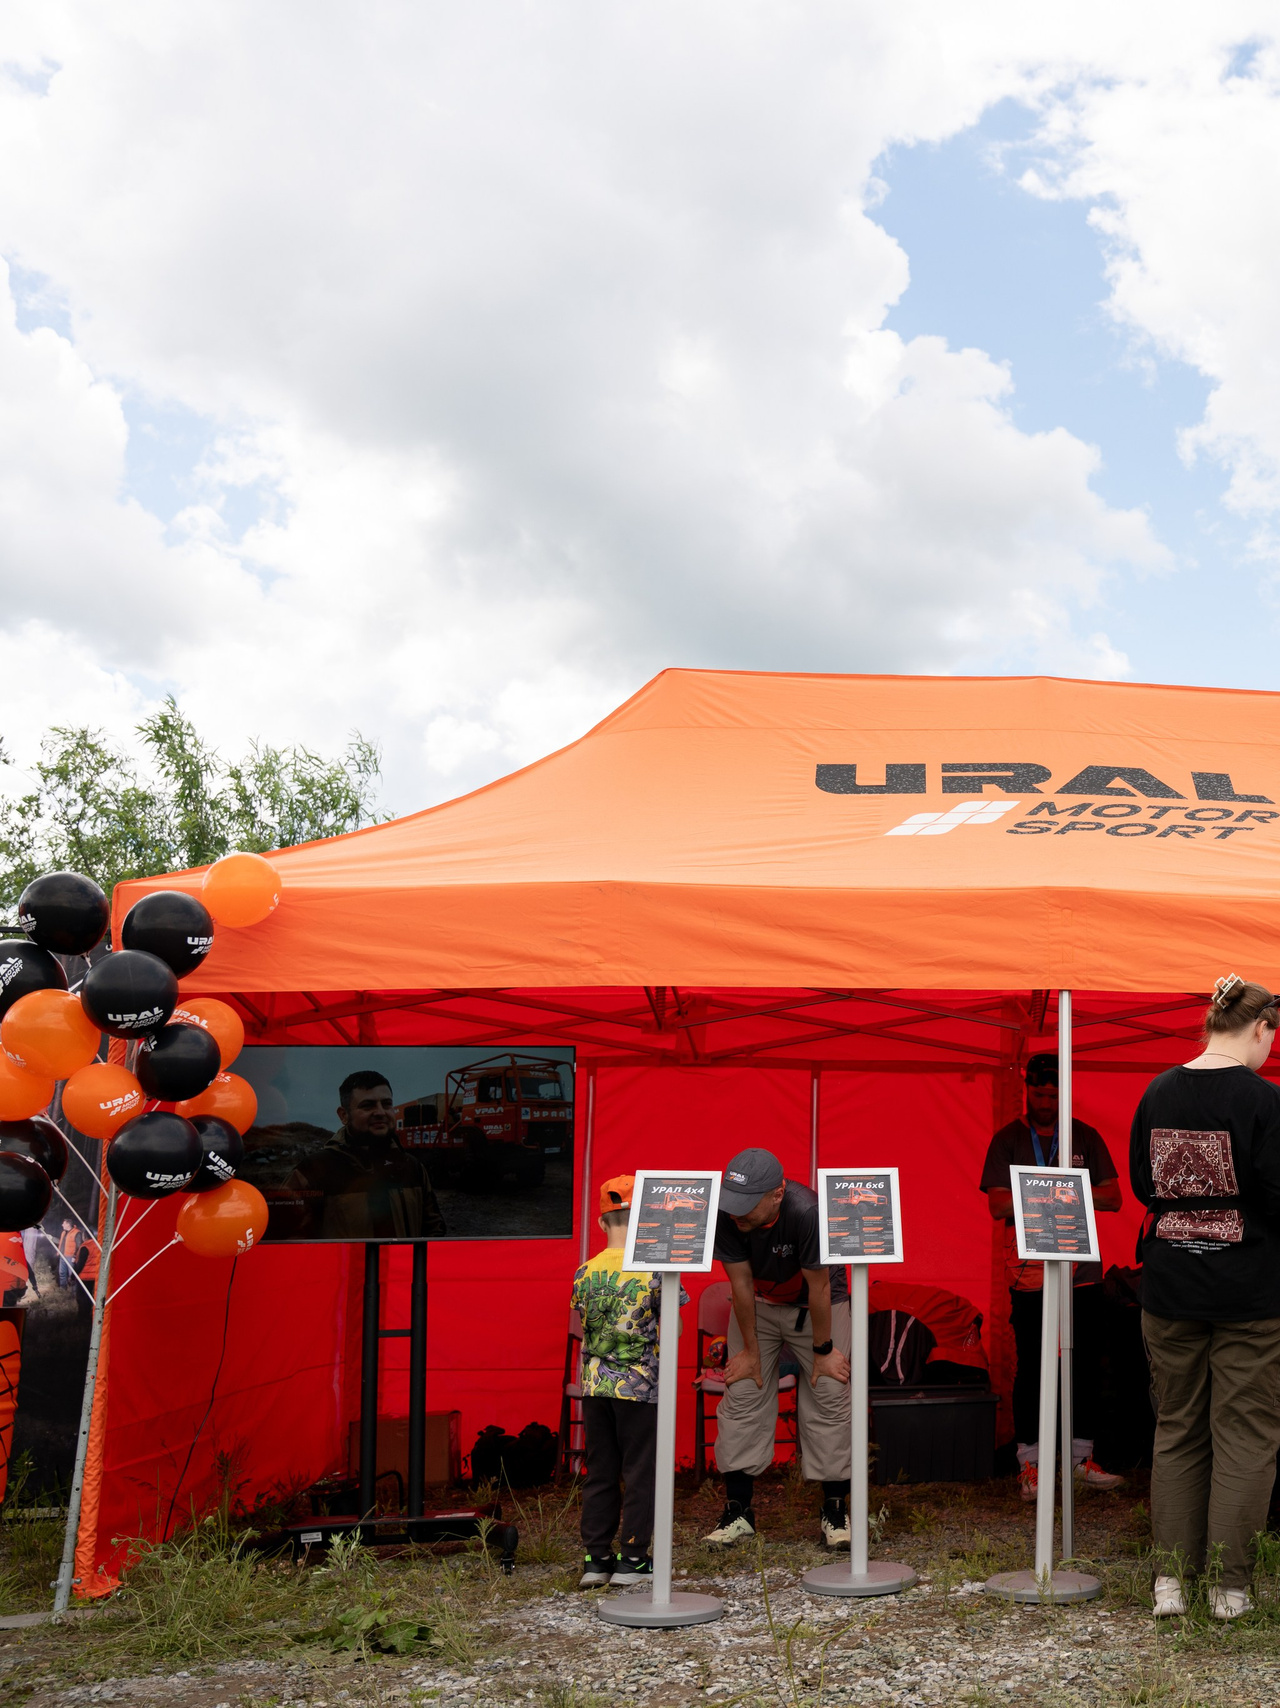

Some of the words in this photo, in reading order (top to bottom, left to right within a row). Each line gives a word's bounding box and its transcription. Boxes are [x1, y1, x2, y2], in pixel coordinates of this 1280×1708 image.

[815, 762, 1276, 804] URAL
[1024, 801, 1280, 824] MOTOR
[1005, 820, 1255, 839] SPORT
[2, 958, 23, 982] MOTOR
[4, 964, 24, 986] SPORT
[107, 1006, 164, 1022] URAL
[173, 1009, 208, 1029] URAL
[99, 1089, 139, 1110] URAL
[208, 1150, 236, 1176] URAL
[145, 1171, 192, 1182] URAL
[865, 1181, 885, 1189] 6x6
[651, 1186, 683, 1194] УРАЛ
